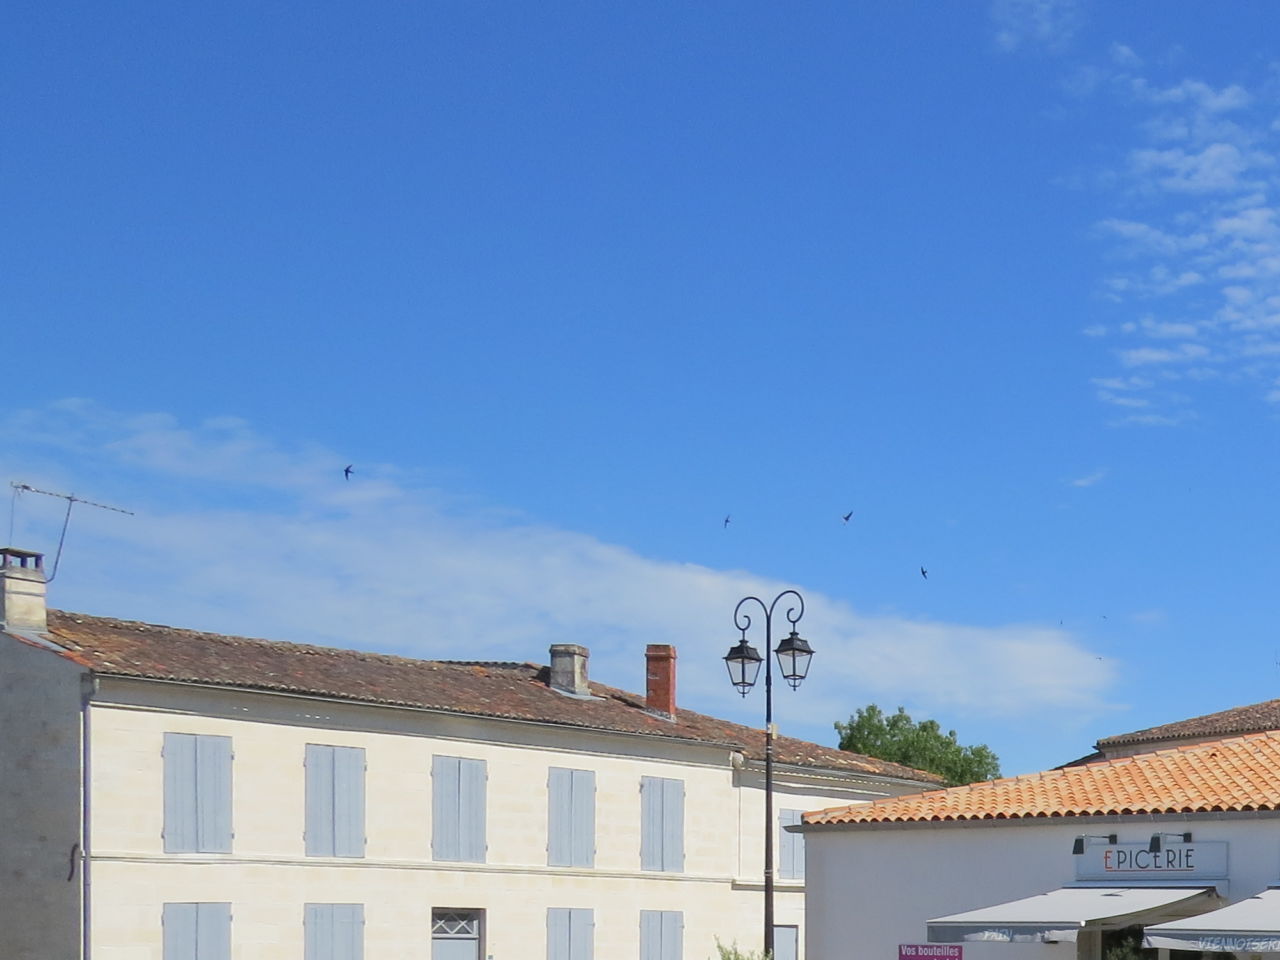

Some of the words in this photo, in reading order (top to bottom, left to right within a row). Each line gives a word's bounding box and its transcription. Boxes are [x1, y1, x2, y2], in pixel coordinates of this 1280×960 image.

[1104, 848, 1195, 870] EPICERIE
[901, 945, 916, 956] Vos
[918, 945, 959, 957] bouteilles
